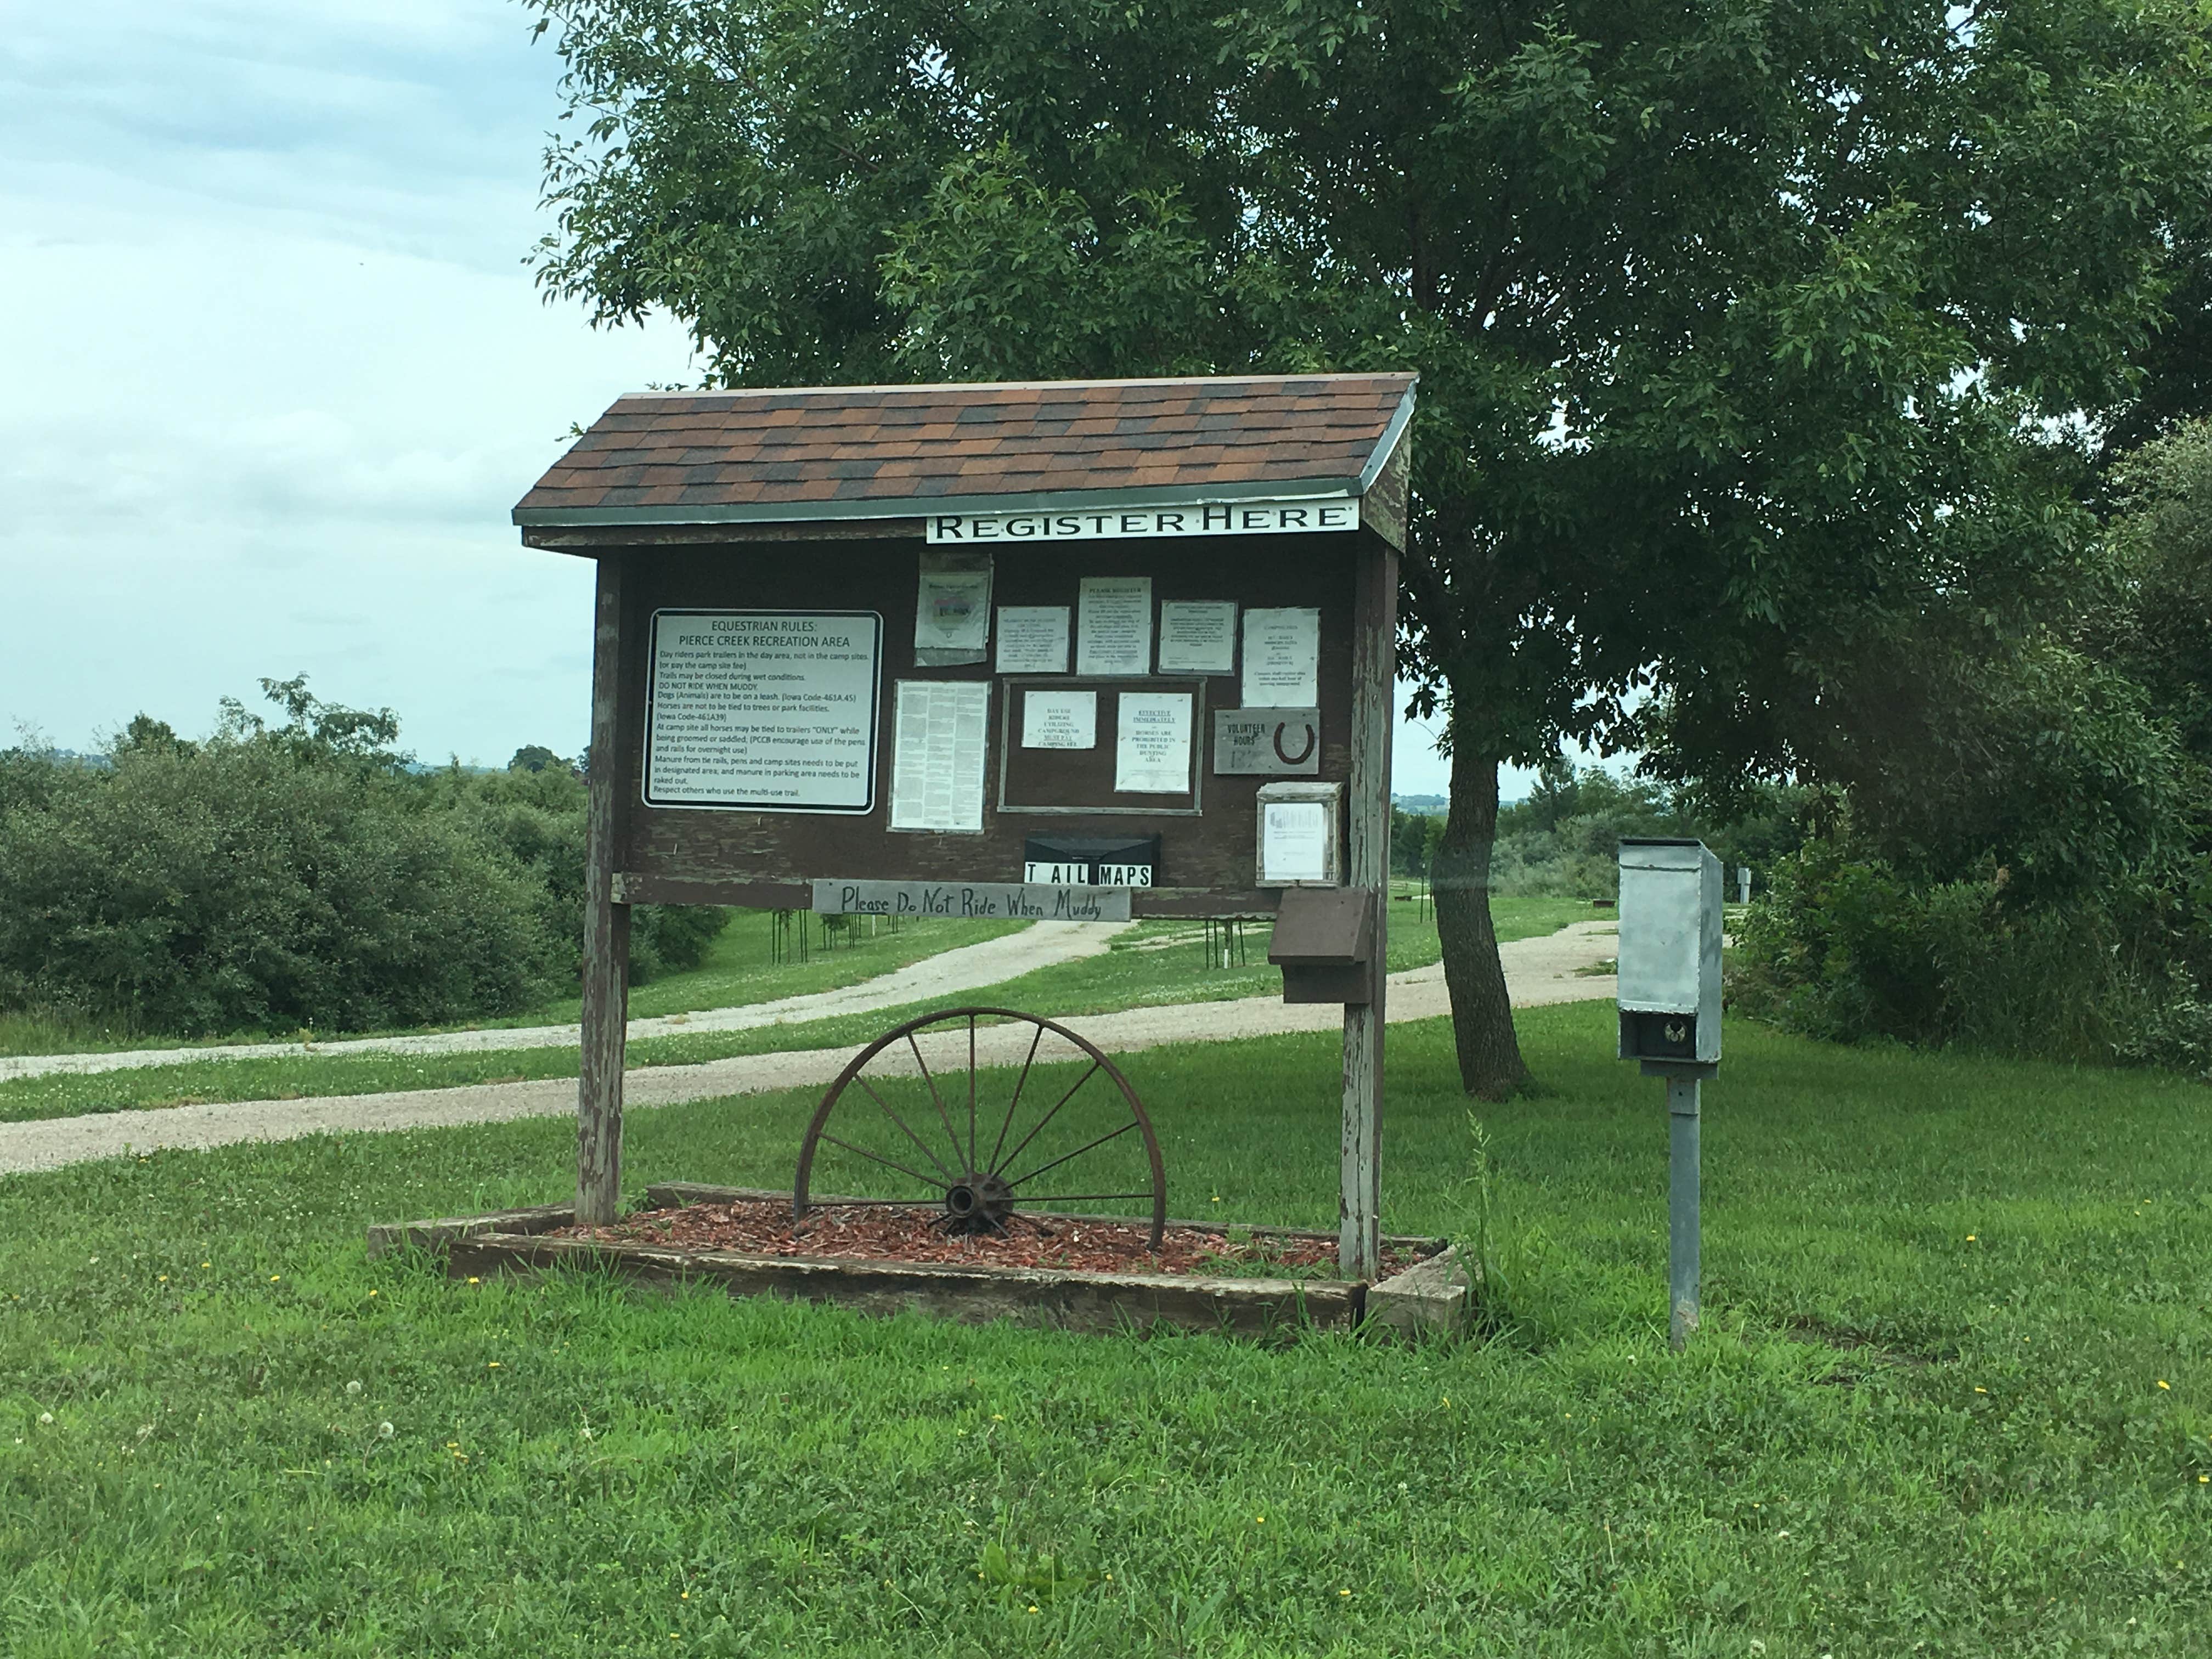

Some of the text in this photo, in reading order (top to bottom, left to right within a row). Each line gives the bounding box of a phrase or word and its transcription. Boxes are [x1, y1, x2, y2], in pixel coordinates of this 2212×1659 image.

[936, 505, 1347, 539] REGISTER HERE
[712, 620, 817, 633] EQUESTRIAN RULES:
[679, 635, 850, 647] PIERCE CREEK RECREATION AREA
[659, 650, 673, 659] Day
[695, 650, 711, 660] park
[712, 650, 737, 658] trailers
[759, 651, 773, 660] day
[659, 661, 746, 670] (or pay the camp site fee)
[658, 671, 677, 681] Trails
[704, 672, 727, 680] closed
[728, 672, 752, 682] during
[659, 681, 670, 690] DO
[671, 681, 686, 690] NOT
[688, 681, 703, 690] RIDE
[706, 682, 728, 690] WHEN
[657, 690, 675, 700] Dogs
[676, 690, 709, 701] (Animals)
[723, 691, 731, 699] to
[781, 693, 802, 702] (Iowa
[657, 701, 680, 709] Horses
[717, 702, 726, 710] be
[727, 702, 742, 710] tied
[781, 703, 797, 713] park
[656, 712, 676, 721] (Iowa
[656, 723, 664, 731] At
[709, 724, 733, 732] horses
[734, 726, 749, 734] may
[751, 724, 760, 732] be
[761, 724, 775, 733] tied
[839, 726, 860, 735] while
[1227, 724, 1265, 733] VOLUNTEER
[656, 733, 675, 743] being
[676, 733, 708, 744] groomed
[749, 735, 771, 744] (PCCB
[772, 737, 809, 746] encourage
[825, 737, 832, 745] of
[834, 737, 846, 746] the
[1233, 736, 1255, 746] HOURS
[686, 744, 696, 753] for
[697, 745, 731, 755] overnight
[732, 746, 747, 755] use)
[654, 755, 681, 763] Manure
[683, 755, 700, 764] from
[702, 755, 710, 764] tie
[749, 757, 762, 765] and
[802, 758, 823, 766] needs
[834, 759, 844, 767] be
[845, 760, 857, 769] put
[662, 765, 700, 775] designated
[764, 768, 771, 776] in
[772, 768, 799, 778] parking
[817, 769, 839, 778] needs
[850, 770, 860, 778] be
[653, 775, 673, 784] raked
[653, 785, 681, 794] Respect
[681, 786, 704, 794] others
[705, 786, 721, 794] who
[736, 787, 748, 795] the
[749, 787, 783, 796] multi-use
[1101, 866, 1149, 885] MAPS
[842, 885, 1102, 921] Please Do Not Ride When Muddy
